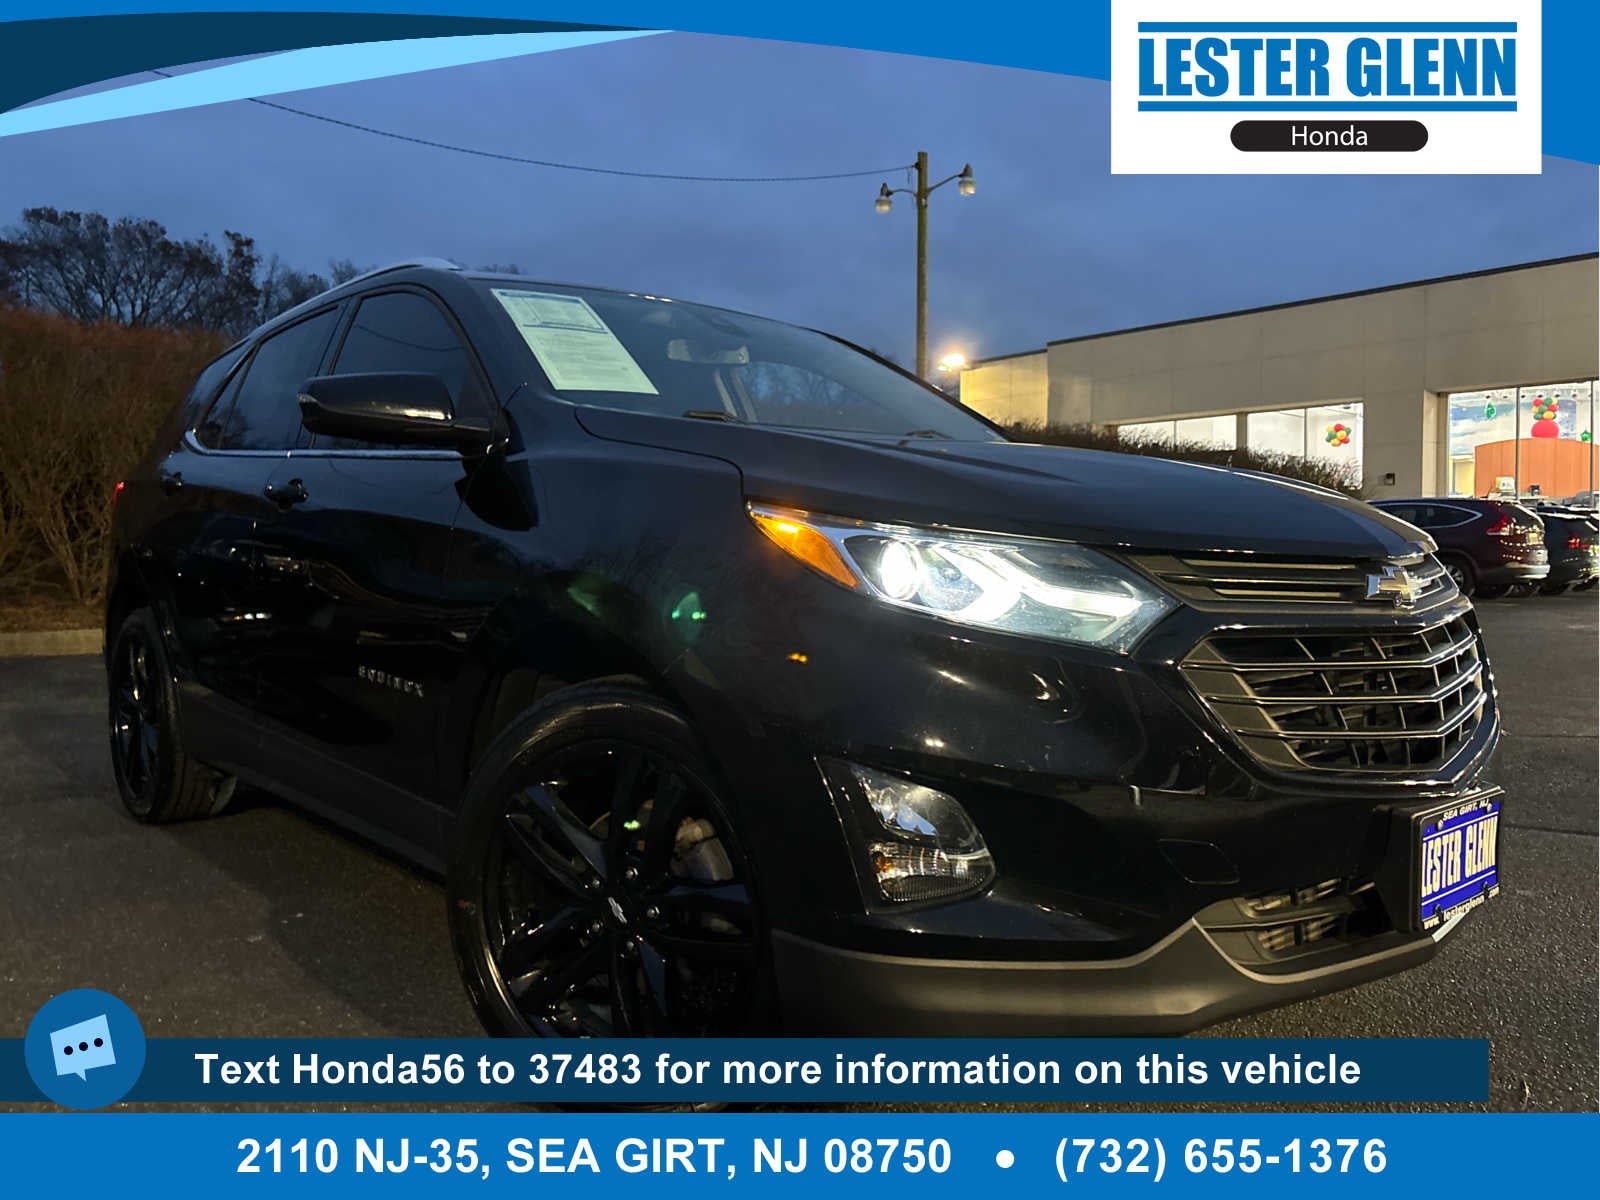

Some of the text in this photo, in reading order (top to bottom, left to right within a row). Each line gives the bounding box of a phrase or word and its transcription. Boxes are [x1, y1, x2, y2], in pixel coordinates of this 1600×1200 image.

[1443, 808, 1458, 821] SEA
[1421, 815, 1498, 898] LESTER GLENN
